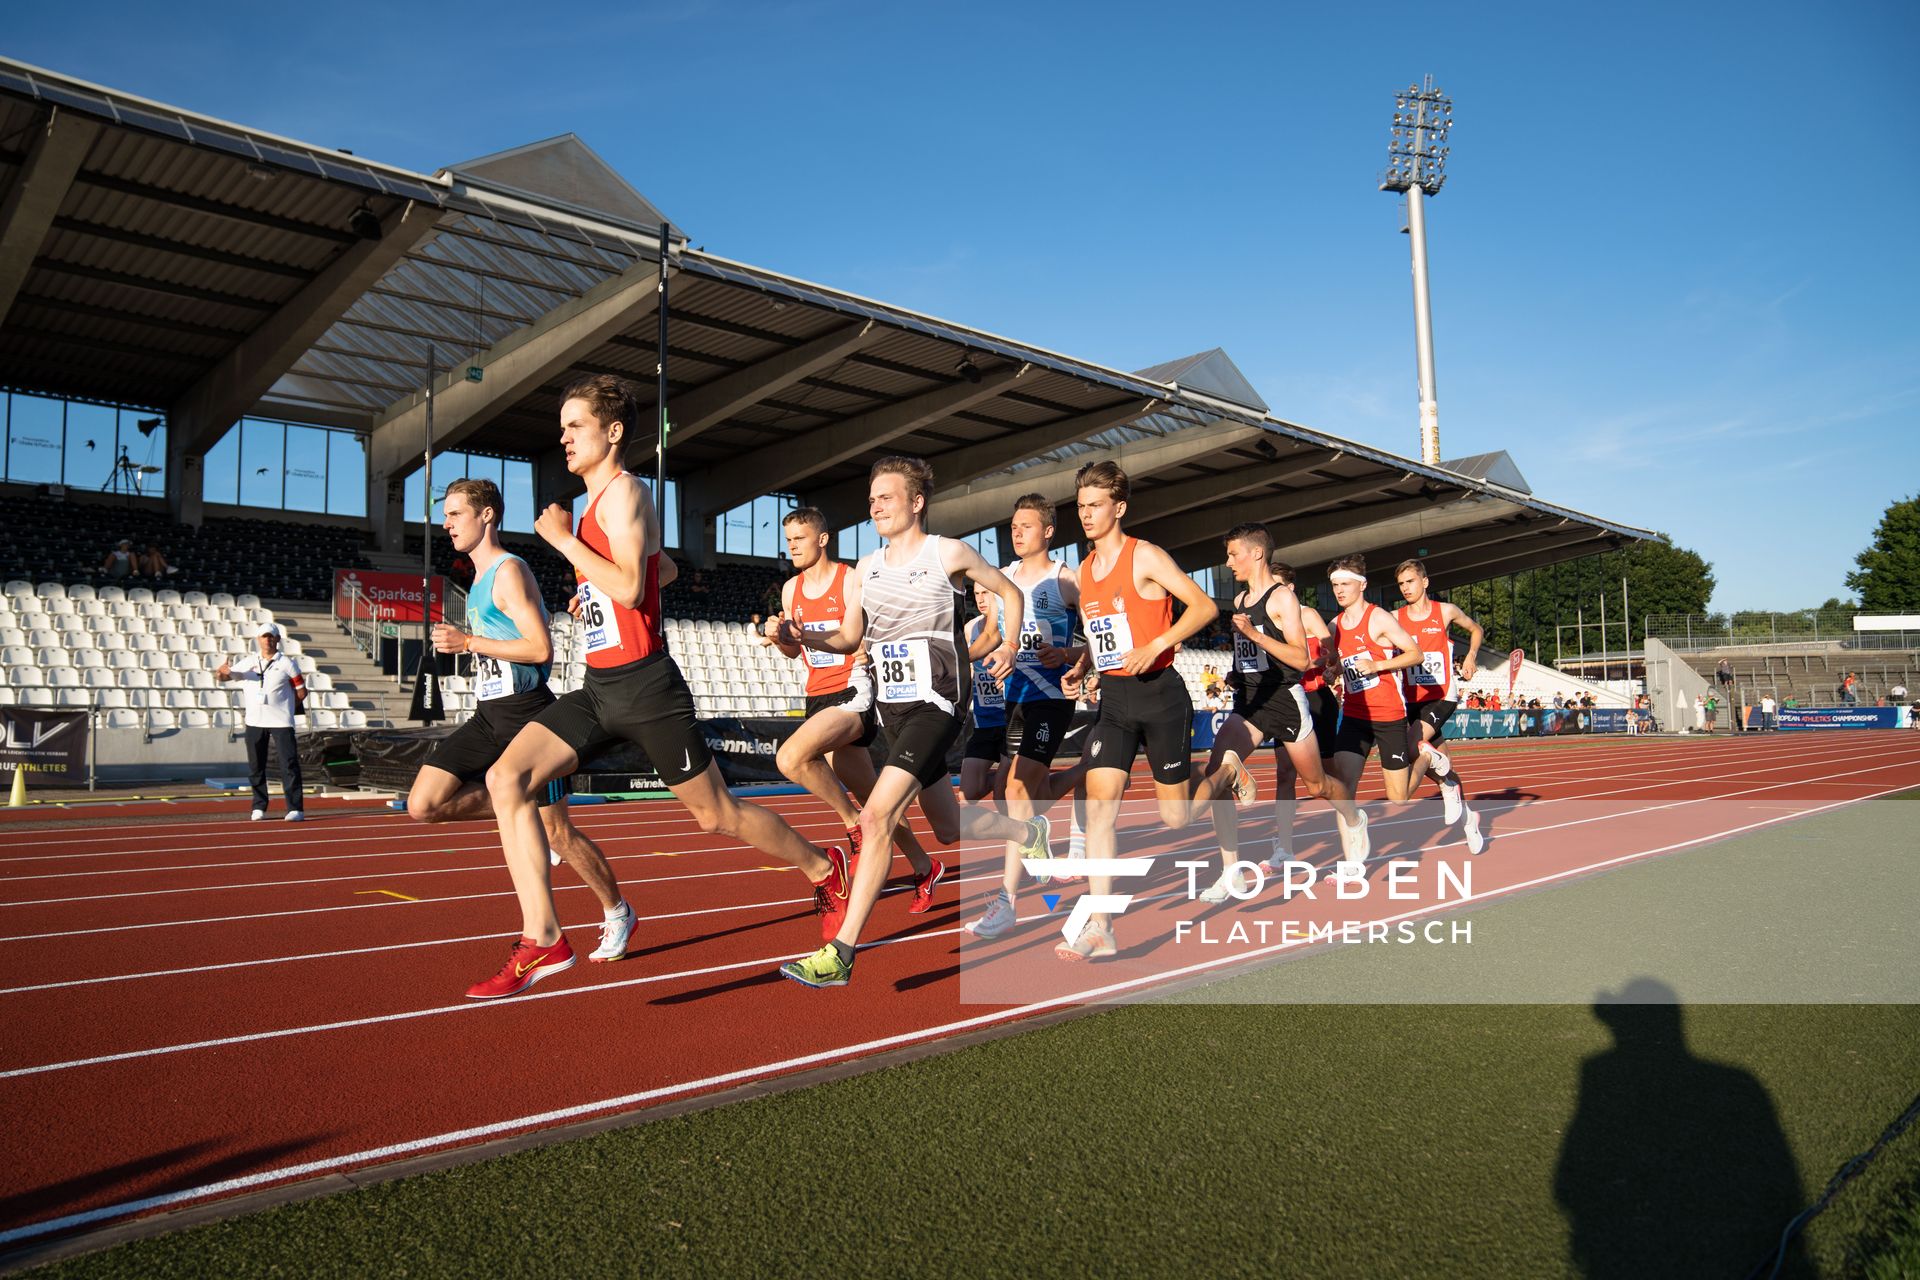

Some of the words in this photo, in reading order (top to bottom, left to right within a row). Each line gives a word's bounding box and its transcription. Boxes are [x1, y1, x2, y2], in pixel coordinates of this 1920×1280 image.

[1090, 618, 1112, 633] GLS
[1096, 632, 1117, 653] 78
[881, 643, 909, 658] GLS
[882, 659, 916, 683] 381
[977, 681, 999, 695] 126
